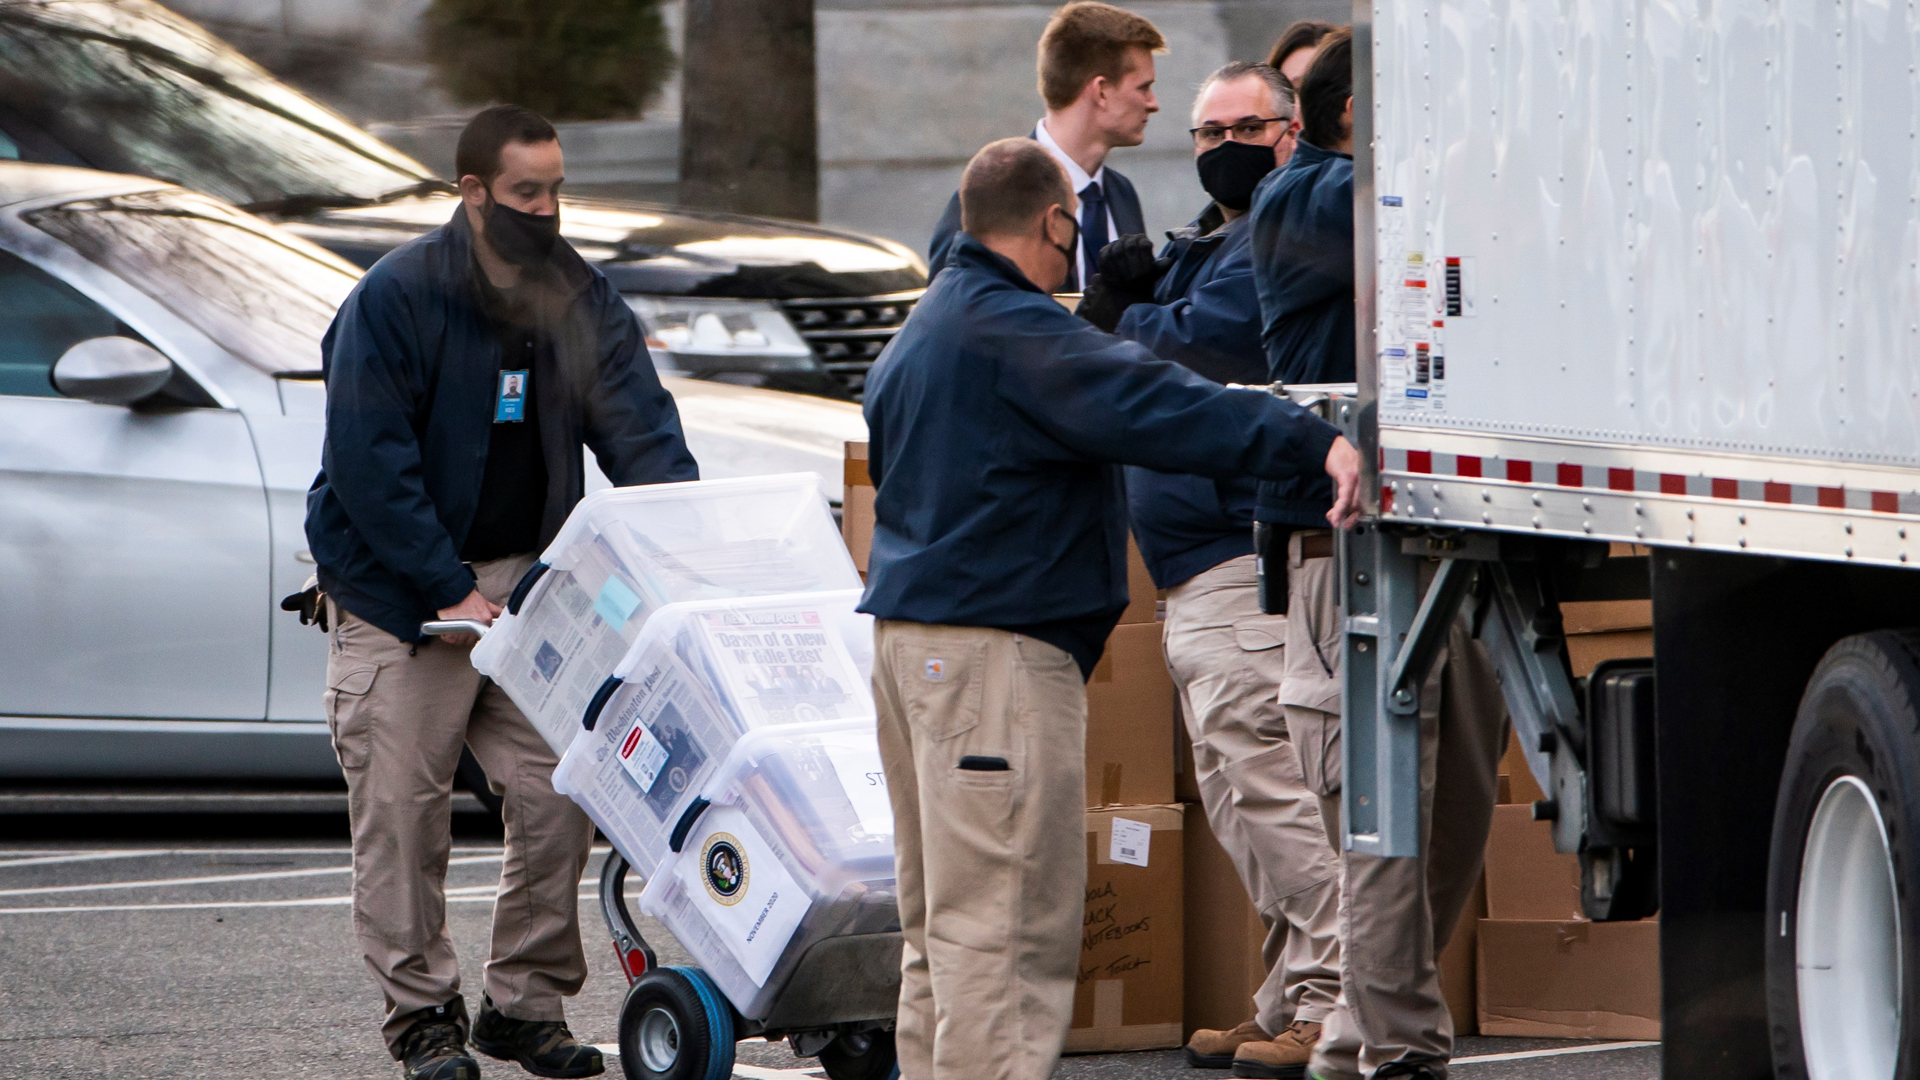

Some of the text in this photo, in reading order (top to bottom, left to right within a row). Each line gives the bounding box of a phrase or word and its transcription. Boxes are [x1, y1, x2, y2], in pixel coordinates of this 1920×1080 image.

[746, 612, 775, 625] YORK
[775, 611, 800, 625] POST
[763, 631, 781, 647] of
[781, 633, 794, 647] a
[794, 632, 828, 646] new
[605, 689, 647, 744] Washington
[644, 665, 662, 693] Post
[746, 892, 778, 943] NOVEMBER 2020
